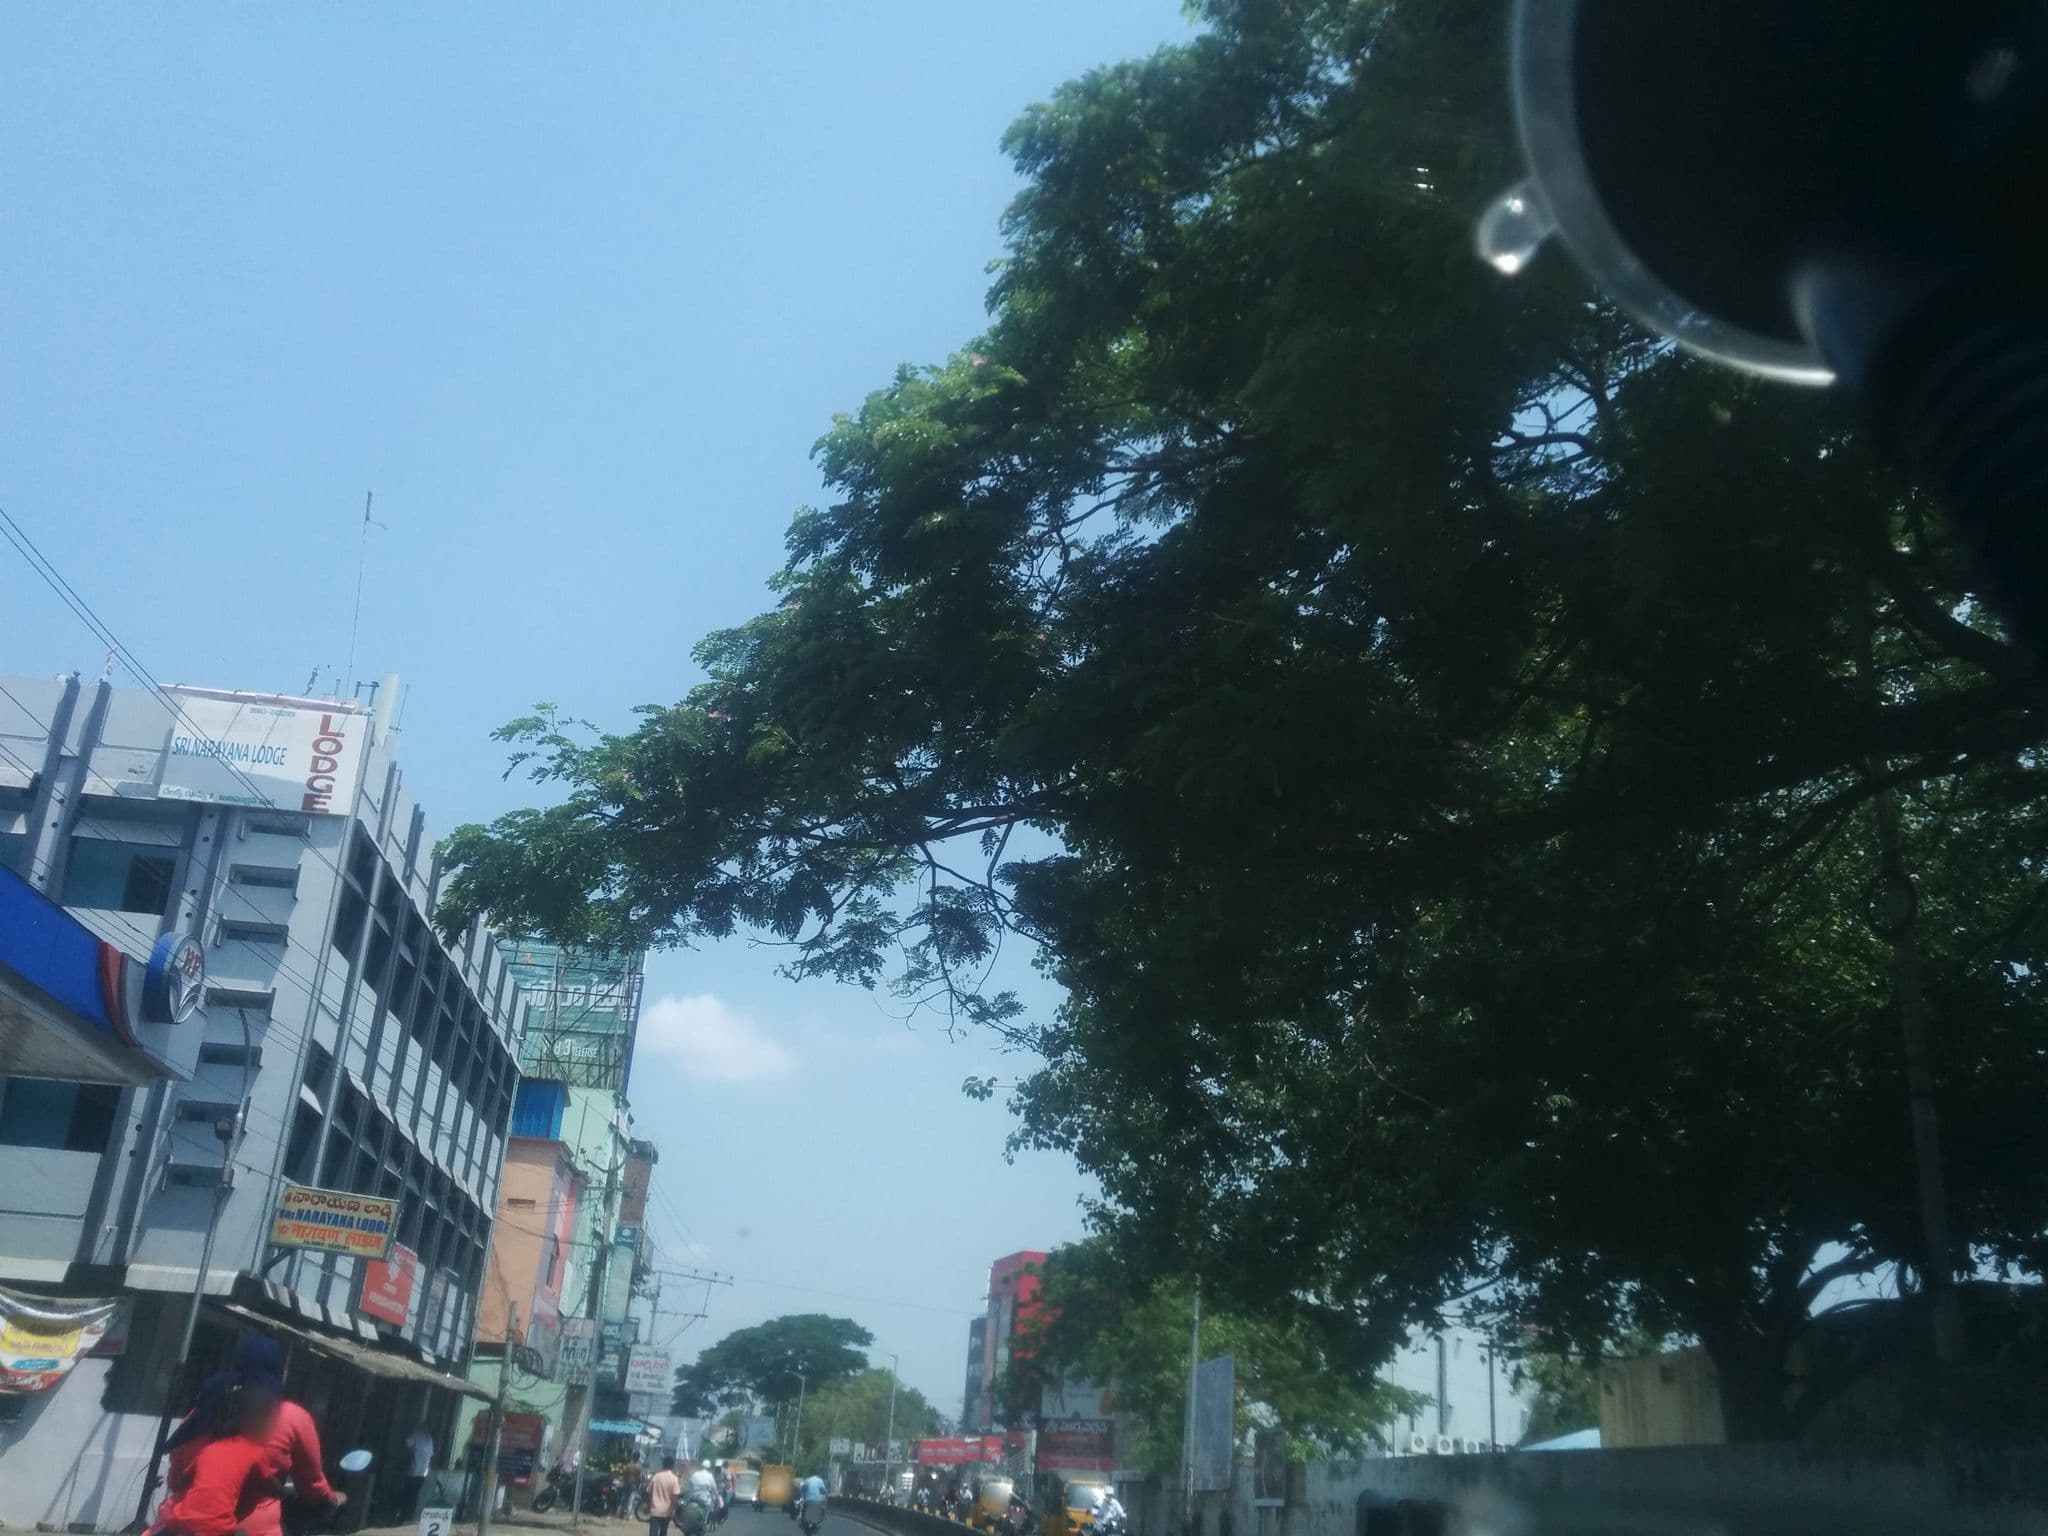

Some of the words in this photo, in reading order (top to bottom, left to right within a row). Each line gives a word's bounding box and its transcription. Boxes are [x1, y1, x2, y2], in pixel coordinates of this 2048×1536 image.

[172, 737, 189, 756] SRI
[193, 738, 249, 762] NARAYANA
[251, 746, 288, 766] LODGE
[301, 714, 345, 813] LODGE
[572, 1045, 598, 1058] RELEASE
[295, 1208, 354, 1228] NARAYANA
[355, 1217, 390, 1234] LODGE
[427, 1522, 440, 1536] 2
